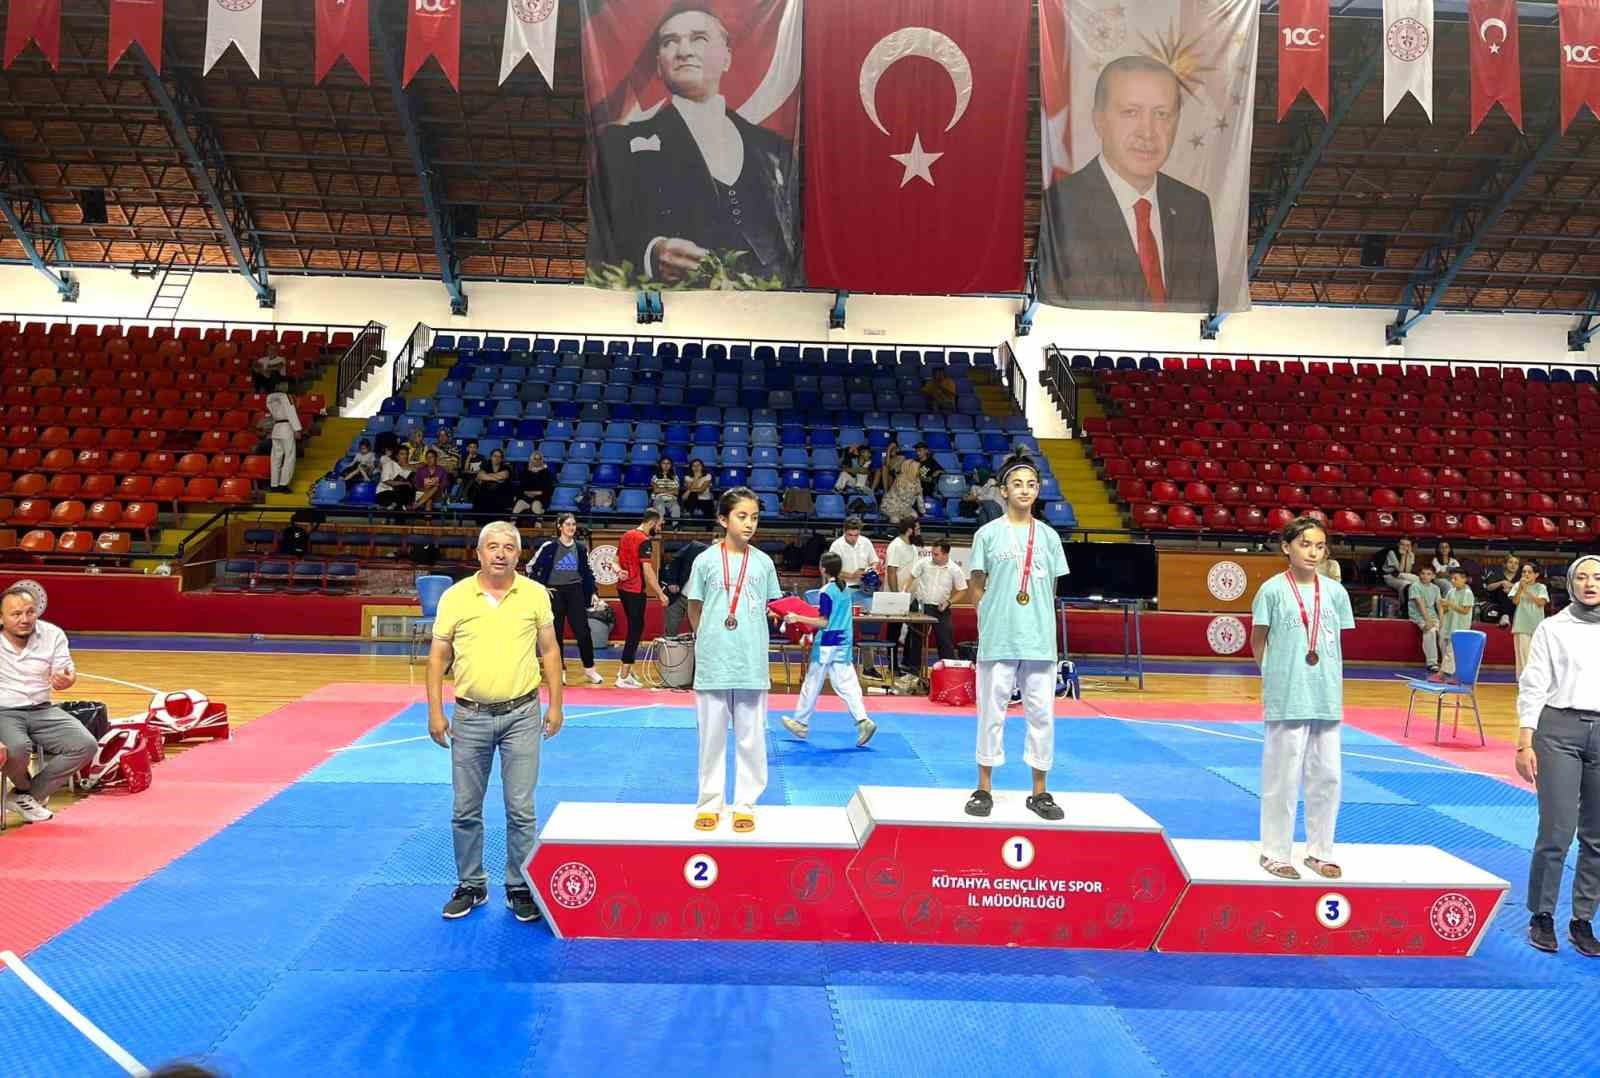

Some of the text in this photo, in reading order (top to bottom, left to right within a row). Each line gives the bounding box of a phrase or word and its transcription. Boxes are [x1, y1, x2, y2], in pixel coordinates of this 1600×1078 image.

[1013, 843, 1023, 862] 1
[694, 861, 708, 881] 2
[931, 874, 1103, 893] KÜTAHYA GENÇLİK VE SPOR
[968, 892, 1066, 909] İL MÜDÜRLÜĞÜ
[1325, 900, 1340, 921] 3
